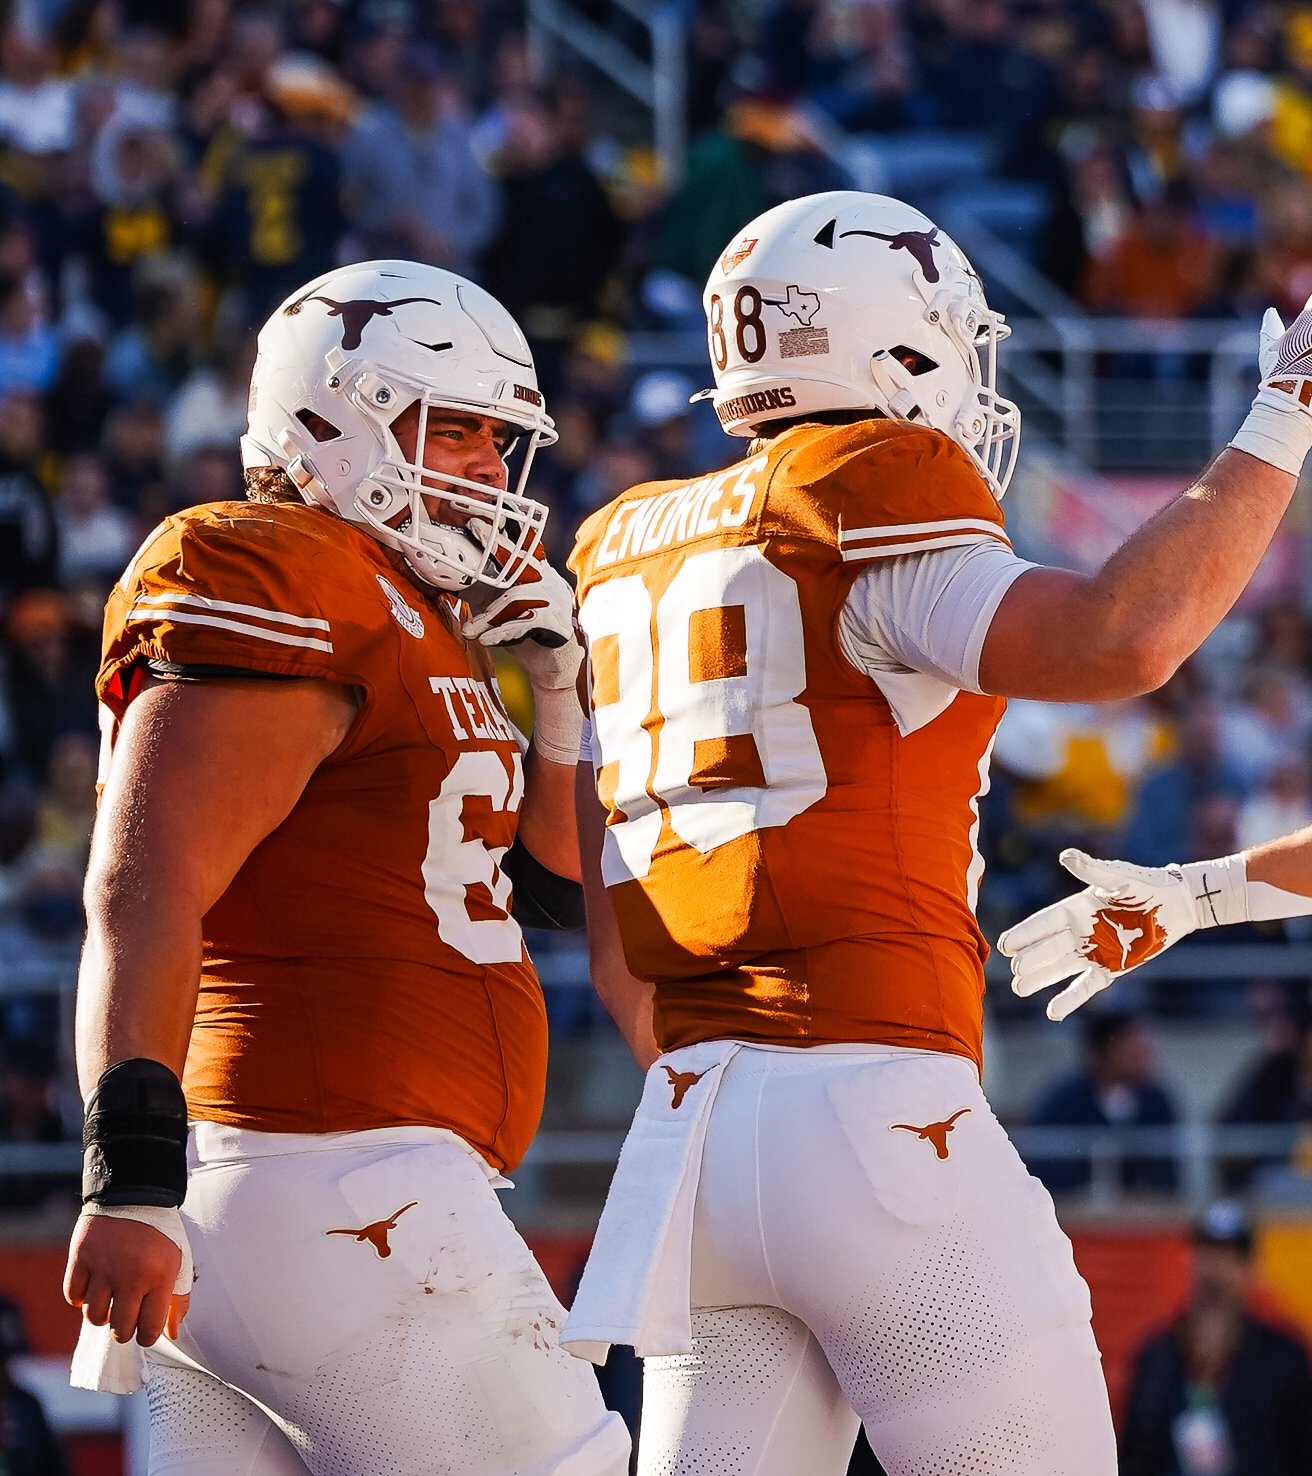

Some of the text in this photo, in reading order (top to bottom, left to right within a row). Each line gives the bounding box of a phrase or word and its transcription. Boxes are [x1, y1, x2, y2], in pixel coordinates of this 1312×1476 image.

[710, 285, 767, 371] 88
[717, 386, 797, 425] ONGHORNS
[597, 456, 769, 567] ENDRIES
[428, 676, 517, 742] TEXA
[578, 545, 828, 888] 88
[421, 750, 536, 965] 6
